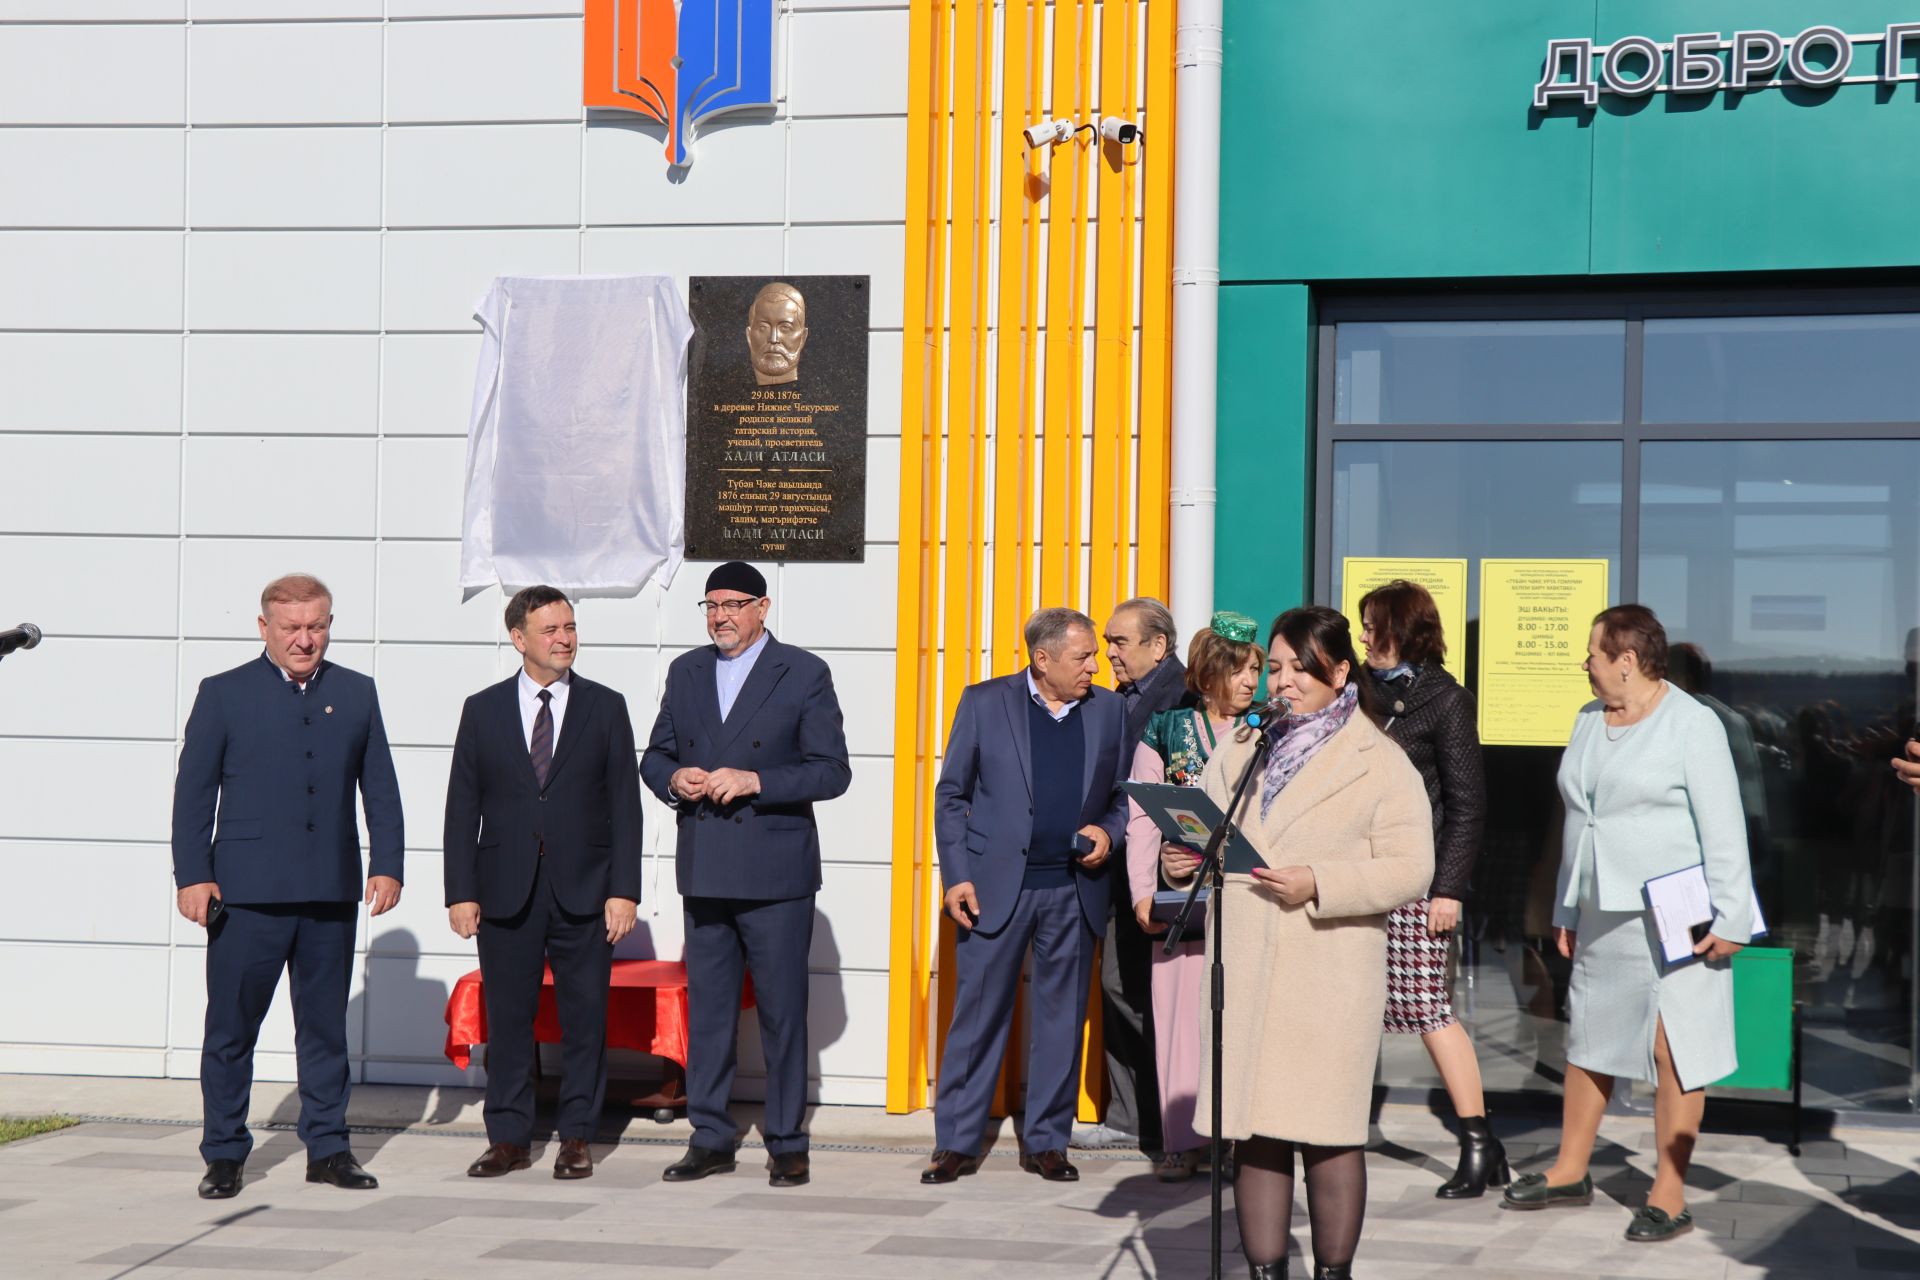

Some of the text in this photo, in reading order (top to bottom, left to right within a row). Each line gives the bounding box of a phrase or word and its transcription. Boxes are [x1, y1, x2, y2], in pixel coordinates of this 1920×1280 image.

[1534, 25, 1853, 109] ДОБРО
[751, 391, 802, 400] 29.08.1876г
[720, 404, 755, 414] деревне
[757, 403, 791, 412] Нижнее
[794, 403, 839, 414] Чекурское
[739, 415, 812, 425] родился великий
[734, 427, 817, 437] татарский историк,
[728, 438, 823, 449] ученый, просветитель
[724, 451, 826, 463] ХАДИ АТЛАСИ
[756, 480, 776, 489] Чәке
[779, 482, 822, 490] авылында
[718, 491, 738, 500] 1876
[770, 491, 780, 500] 29
[782, 493, 832, 503] августында
[755, 505, 778, 514] татар
[780, 504, 831, 514] тарихчысы,
[730, 517, 759, 525] галим,
[770, 528, 824, 540] АТЛАСИ
[761, 543, 785, 551] туган
[1518, 623, 1537, 631] 8.00
[1544, 623, 1569, 631] 17.00
[1517, 640, 1537, 649] 8.00
[1544, 640, 1569, 649] 15.00
